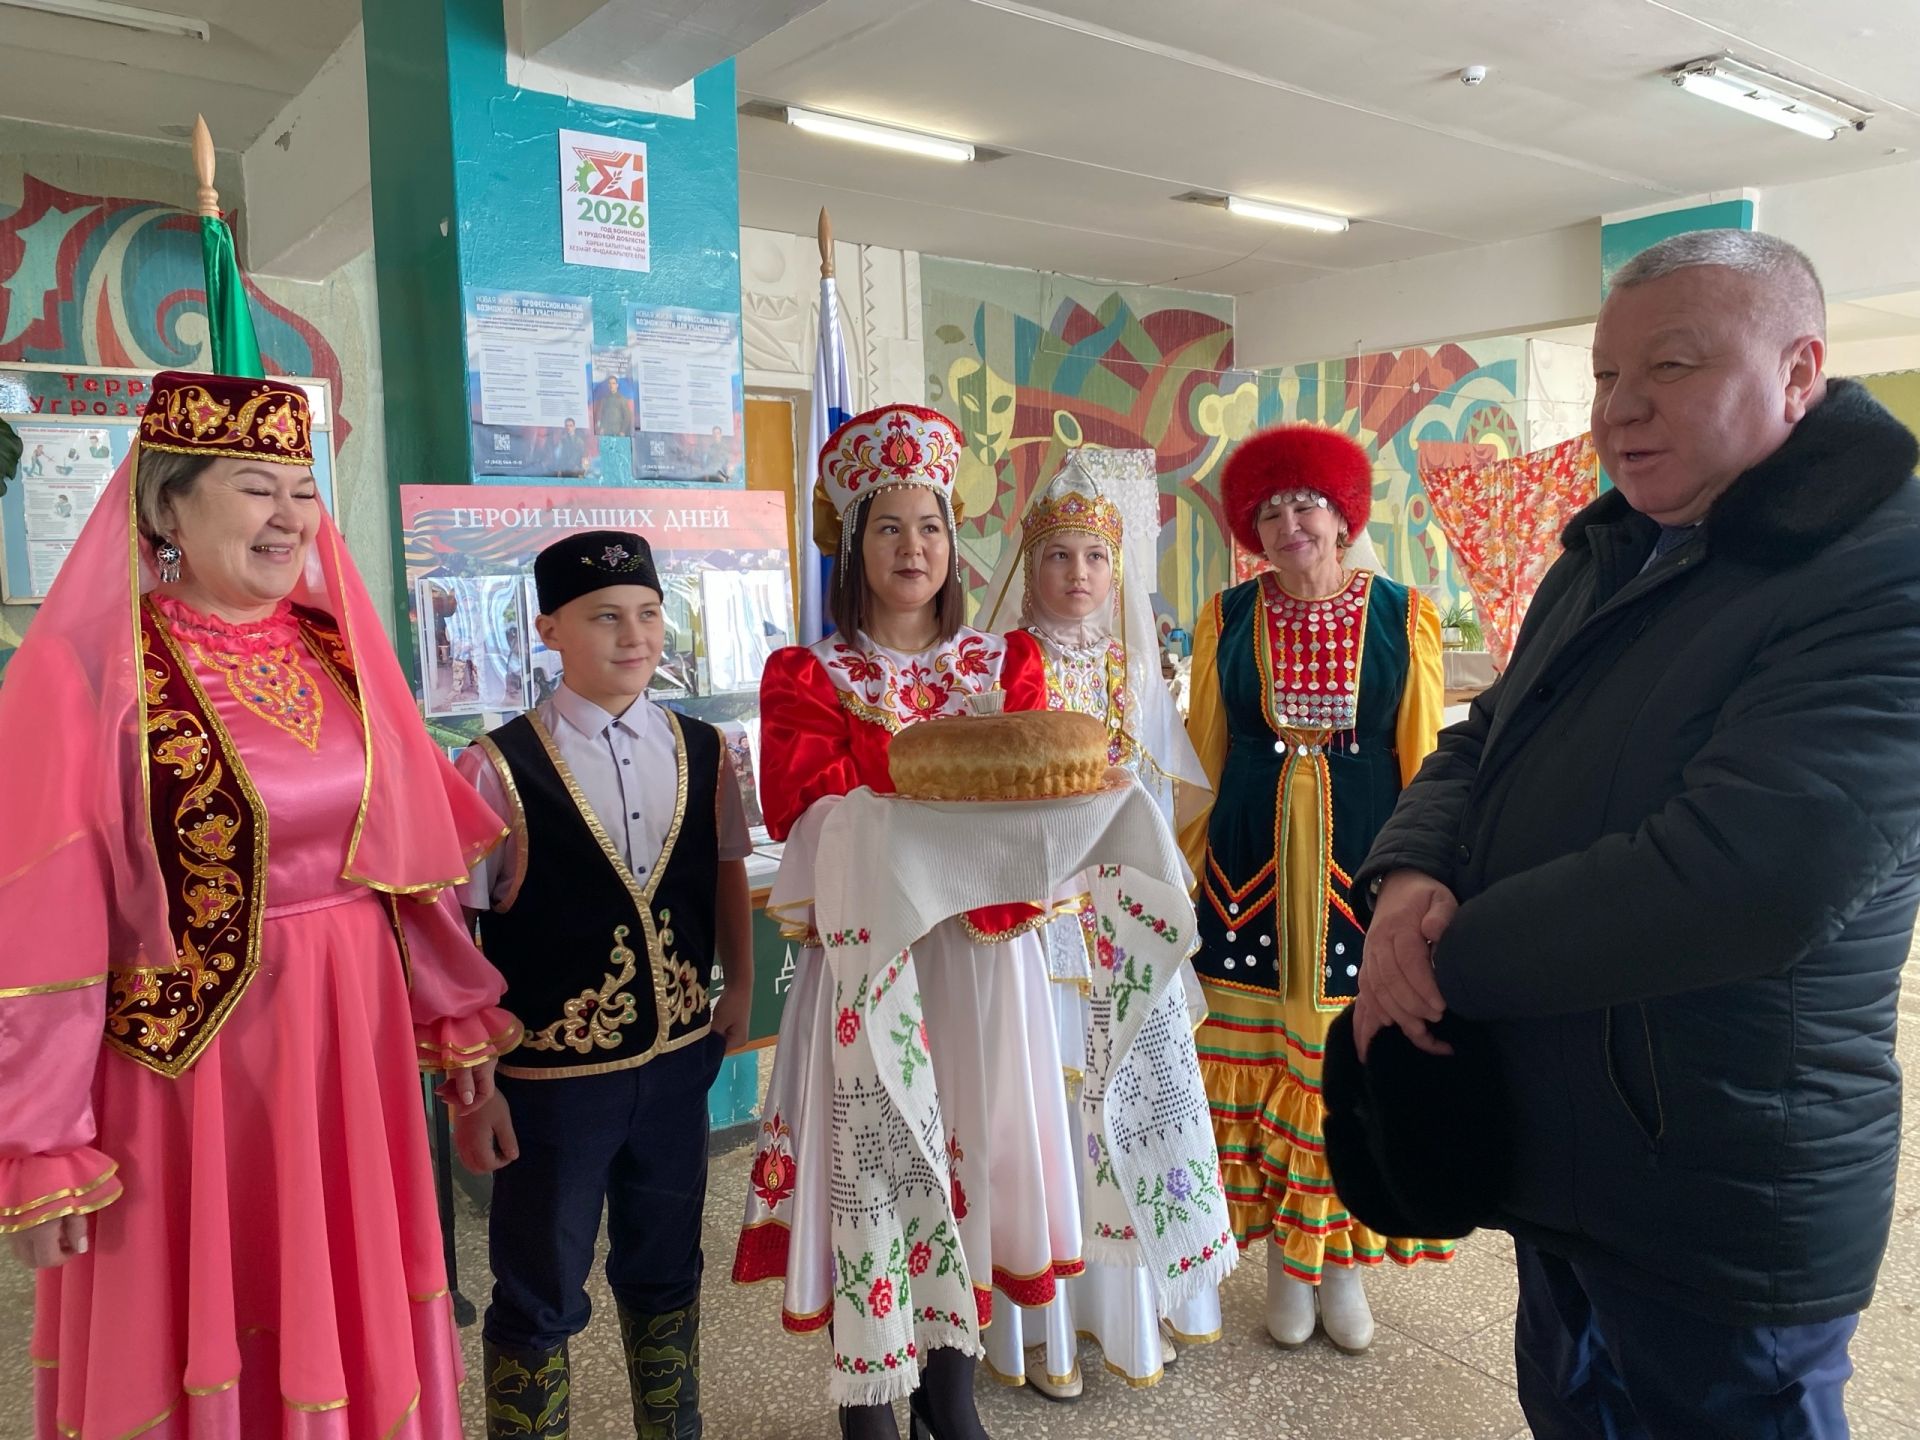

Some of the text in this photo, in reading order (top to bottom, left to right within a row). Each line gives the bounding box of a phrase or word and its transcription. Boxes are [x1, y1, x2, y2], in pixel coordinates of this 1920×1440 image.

[577, 197, 645, 229] 2026
[584, 231, 615, 241] ТРУДОВОЙ
[616, 235, 646, 244] ДОБЛЕСТИ
[613, 228, 645, 238] ВОИНСКОЙ
[476, 303, 521, 315] ВОЗМОЖНОСТИ
[522, 307, 535, 316] ДЛЯ
[61, 373, 154, 398] Терр
[451, 505, 730, 532] ГЕРОИ НАШИХ ДНЕЙ
